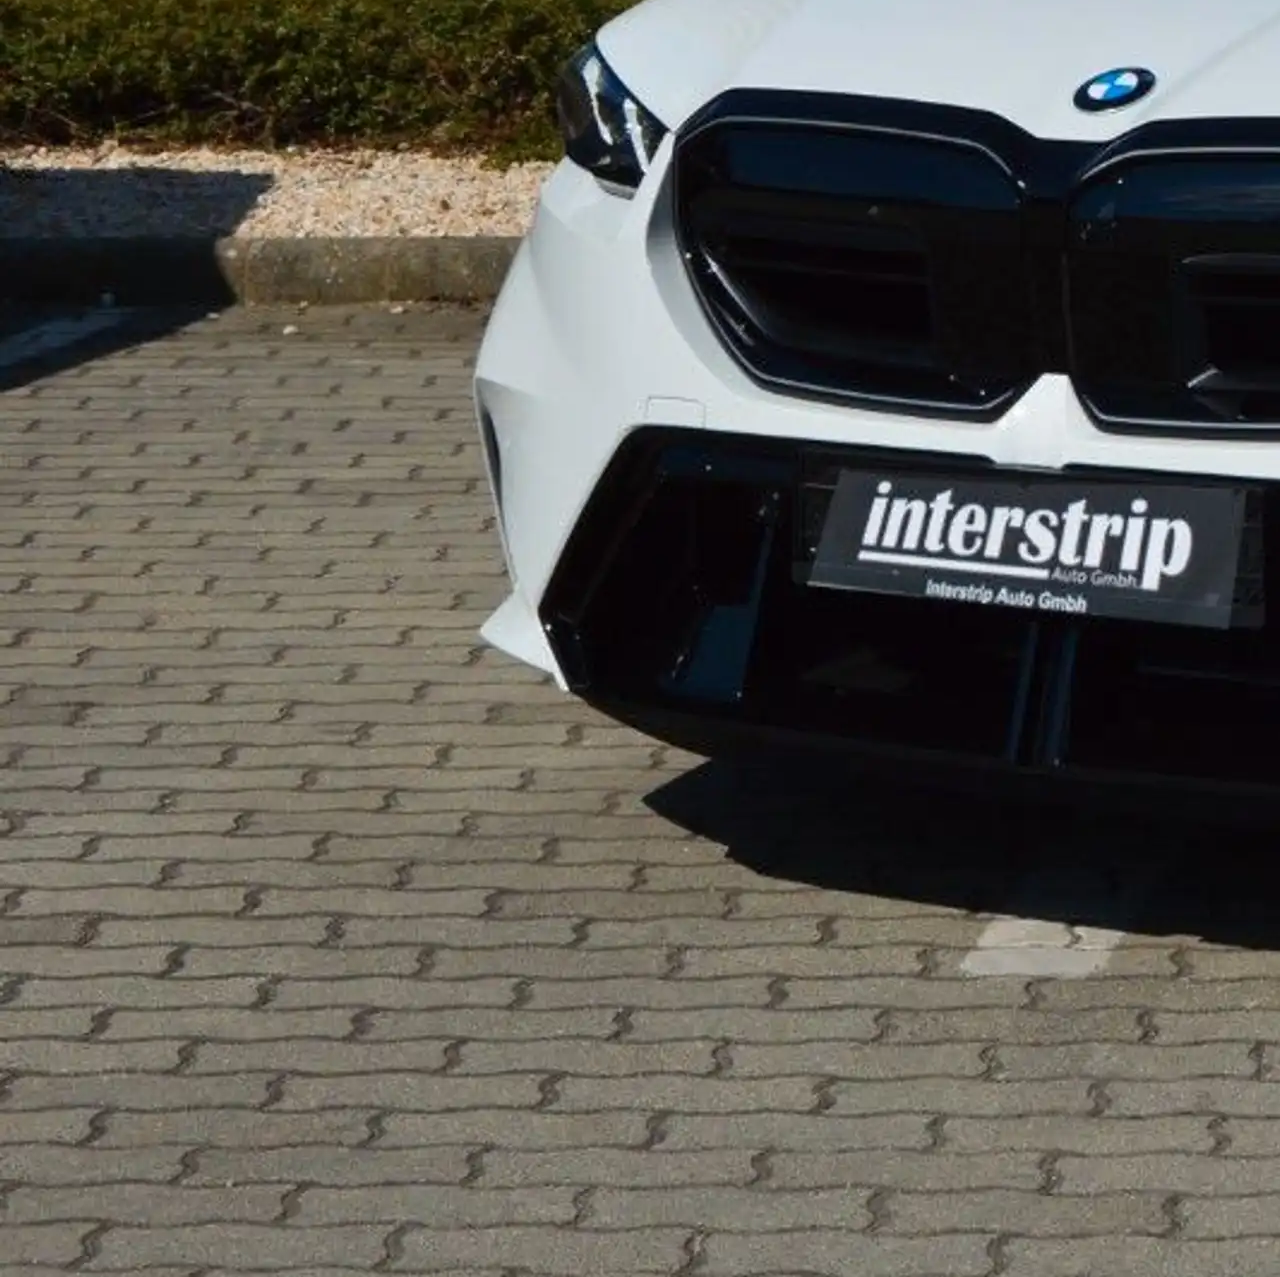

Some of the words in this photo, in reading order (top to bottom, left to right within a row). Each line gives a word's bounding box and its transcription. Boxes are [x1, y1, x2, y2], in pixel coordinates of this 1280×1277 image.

[859, 480, 1193, 591] interstrip
[925, 578, 993, 605] Interstrip
[994, 587, 1035, 609] Auto
[1038, 591, 1088, 614] Gmbh
[1050, 567, 1089, 586] Auto
[1091, 569, 1138, 589] Gmbh
